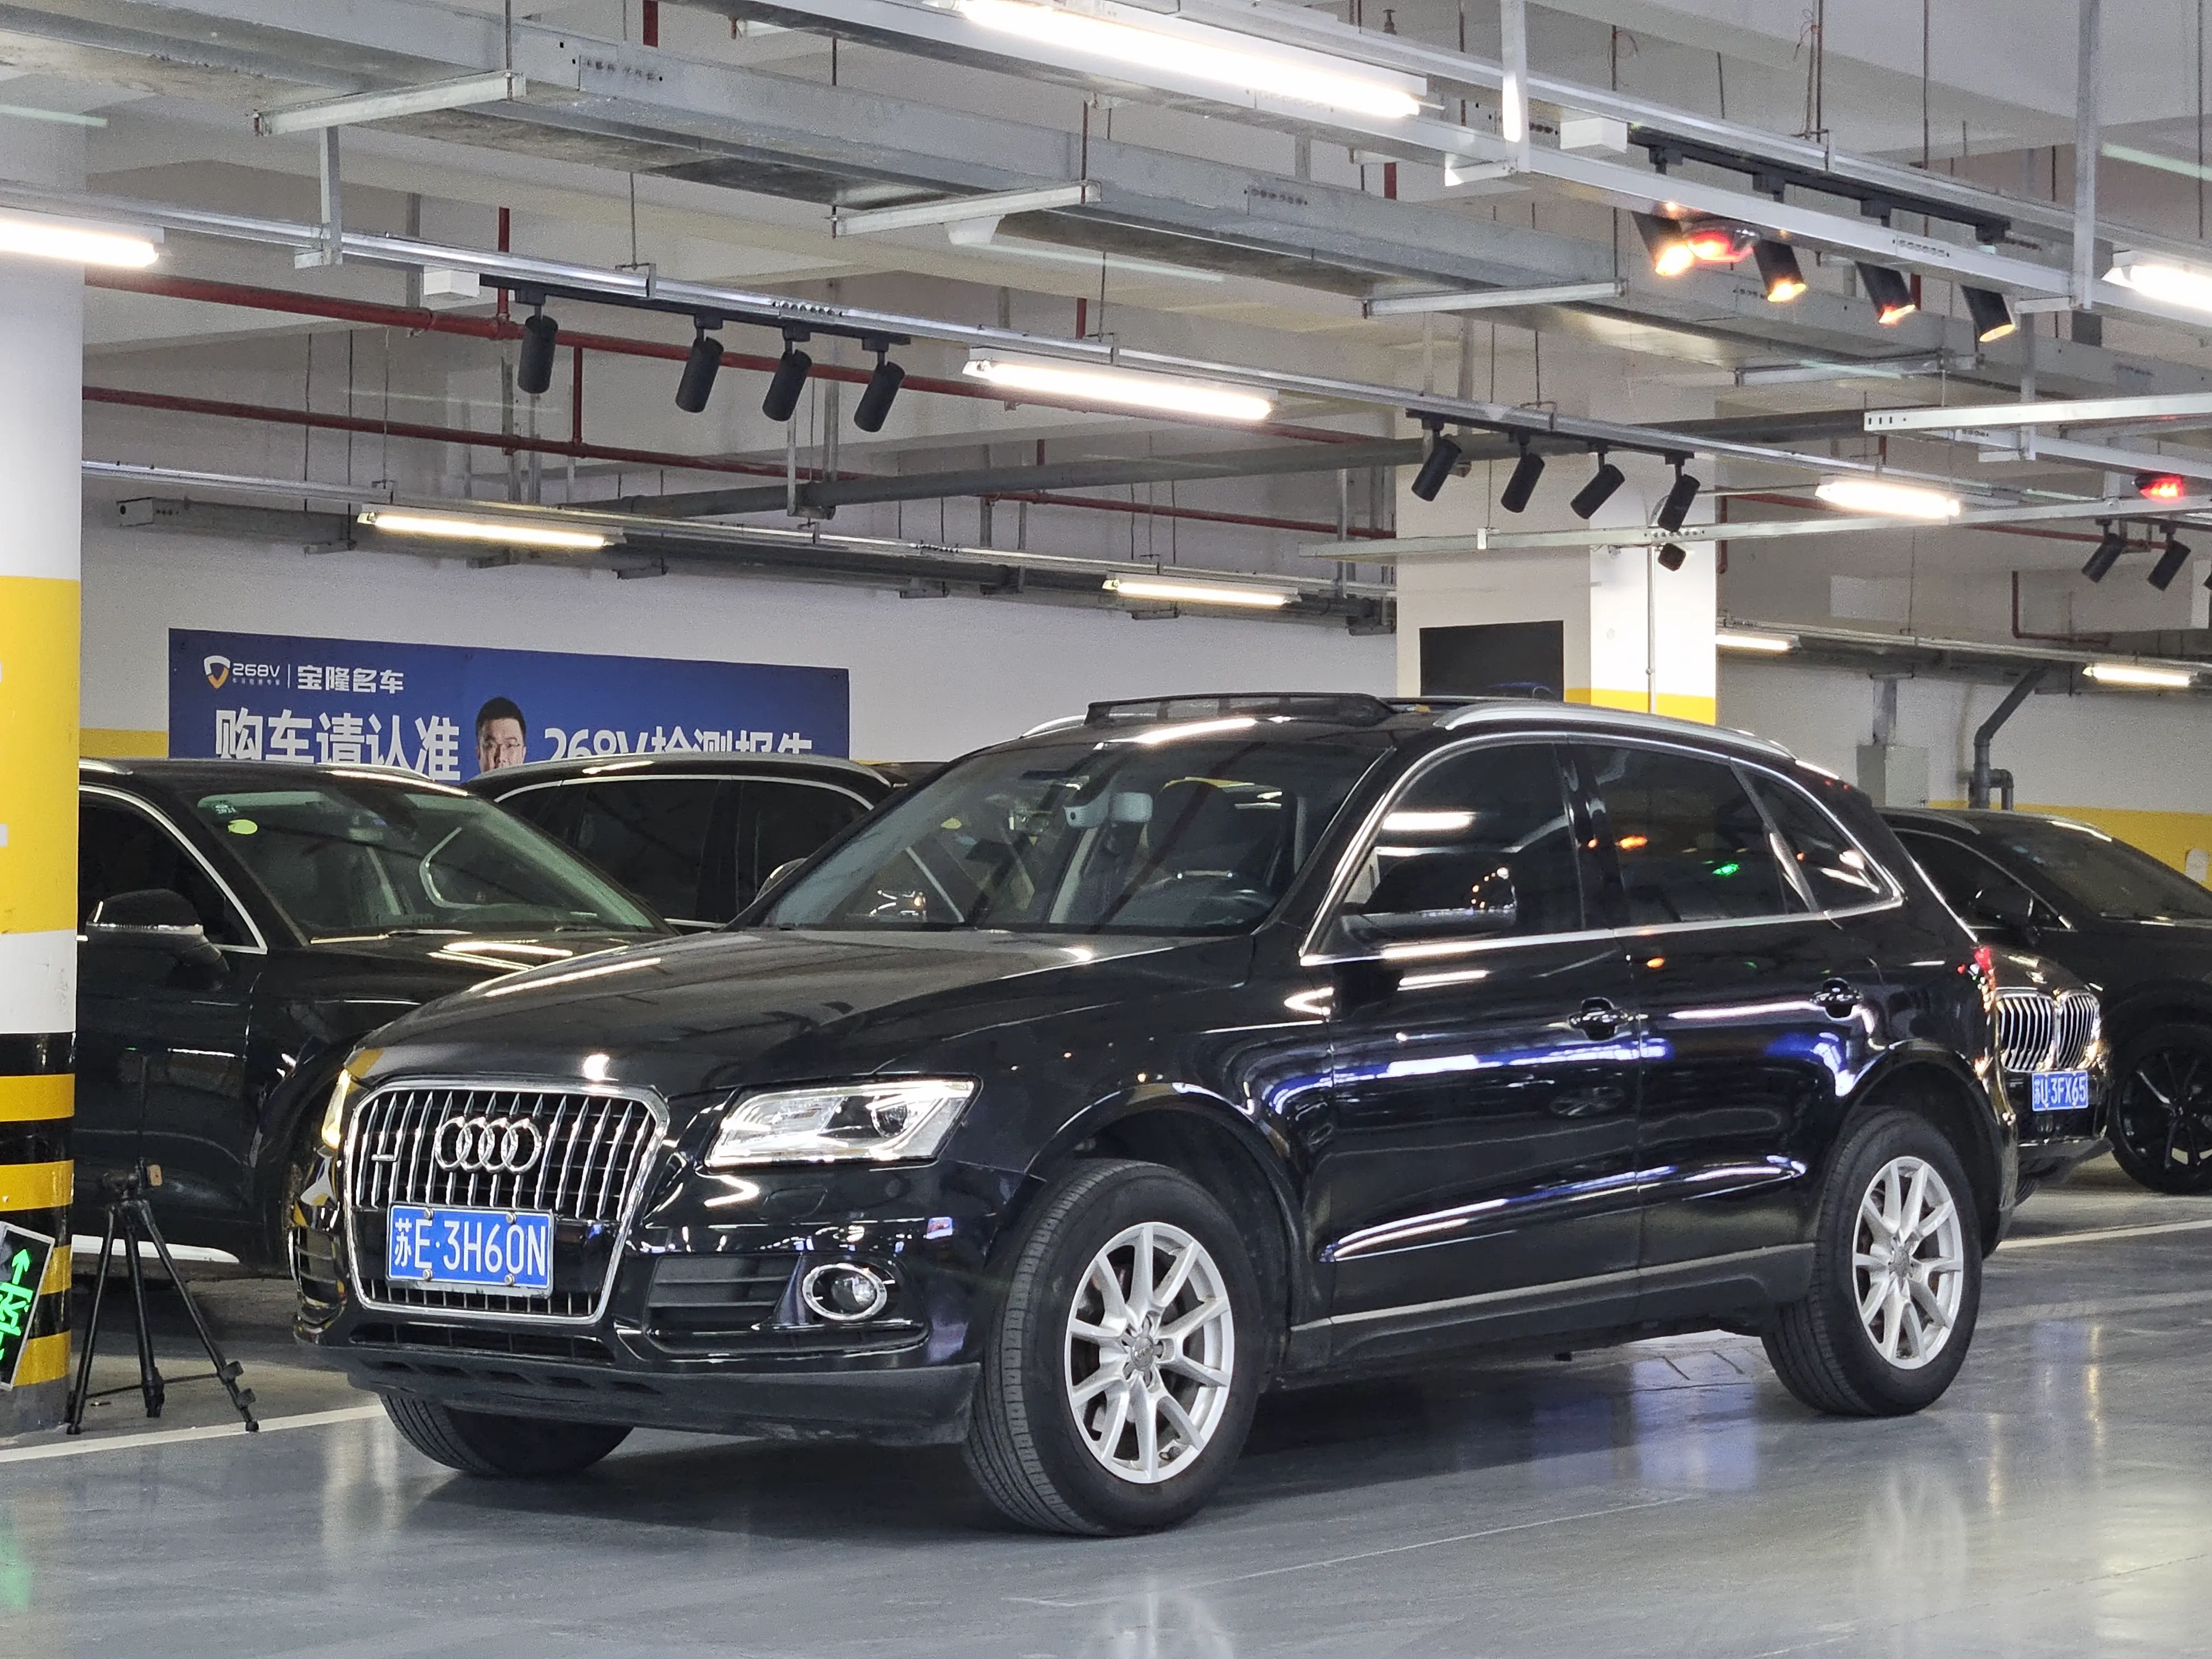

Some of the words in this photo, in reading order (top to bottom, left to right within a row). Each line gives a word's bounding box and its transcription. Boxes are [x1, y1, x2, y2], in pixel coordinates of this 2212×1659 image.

[232, 662, 280, 677] 268V
[298, 664, 404, 693] 宝隆名车
[216, 707, 461, 781] 购车请认准
